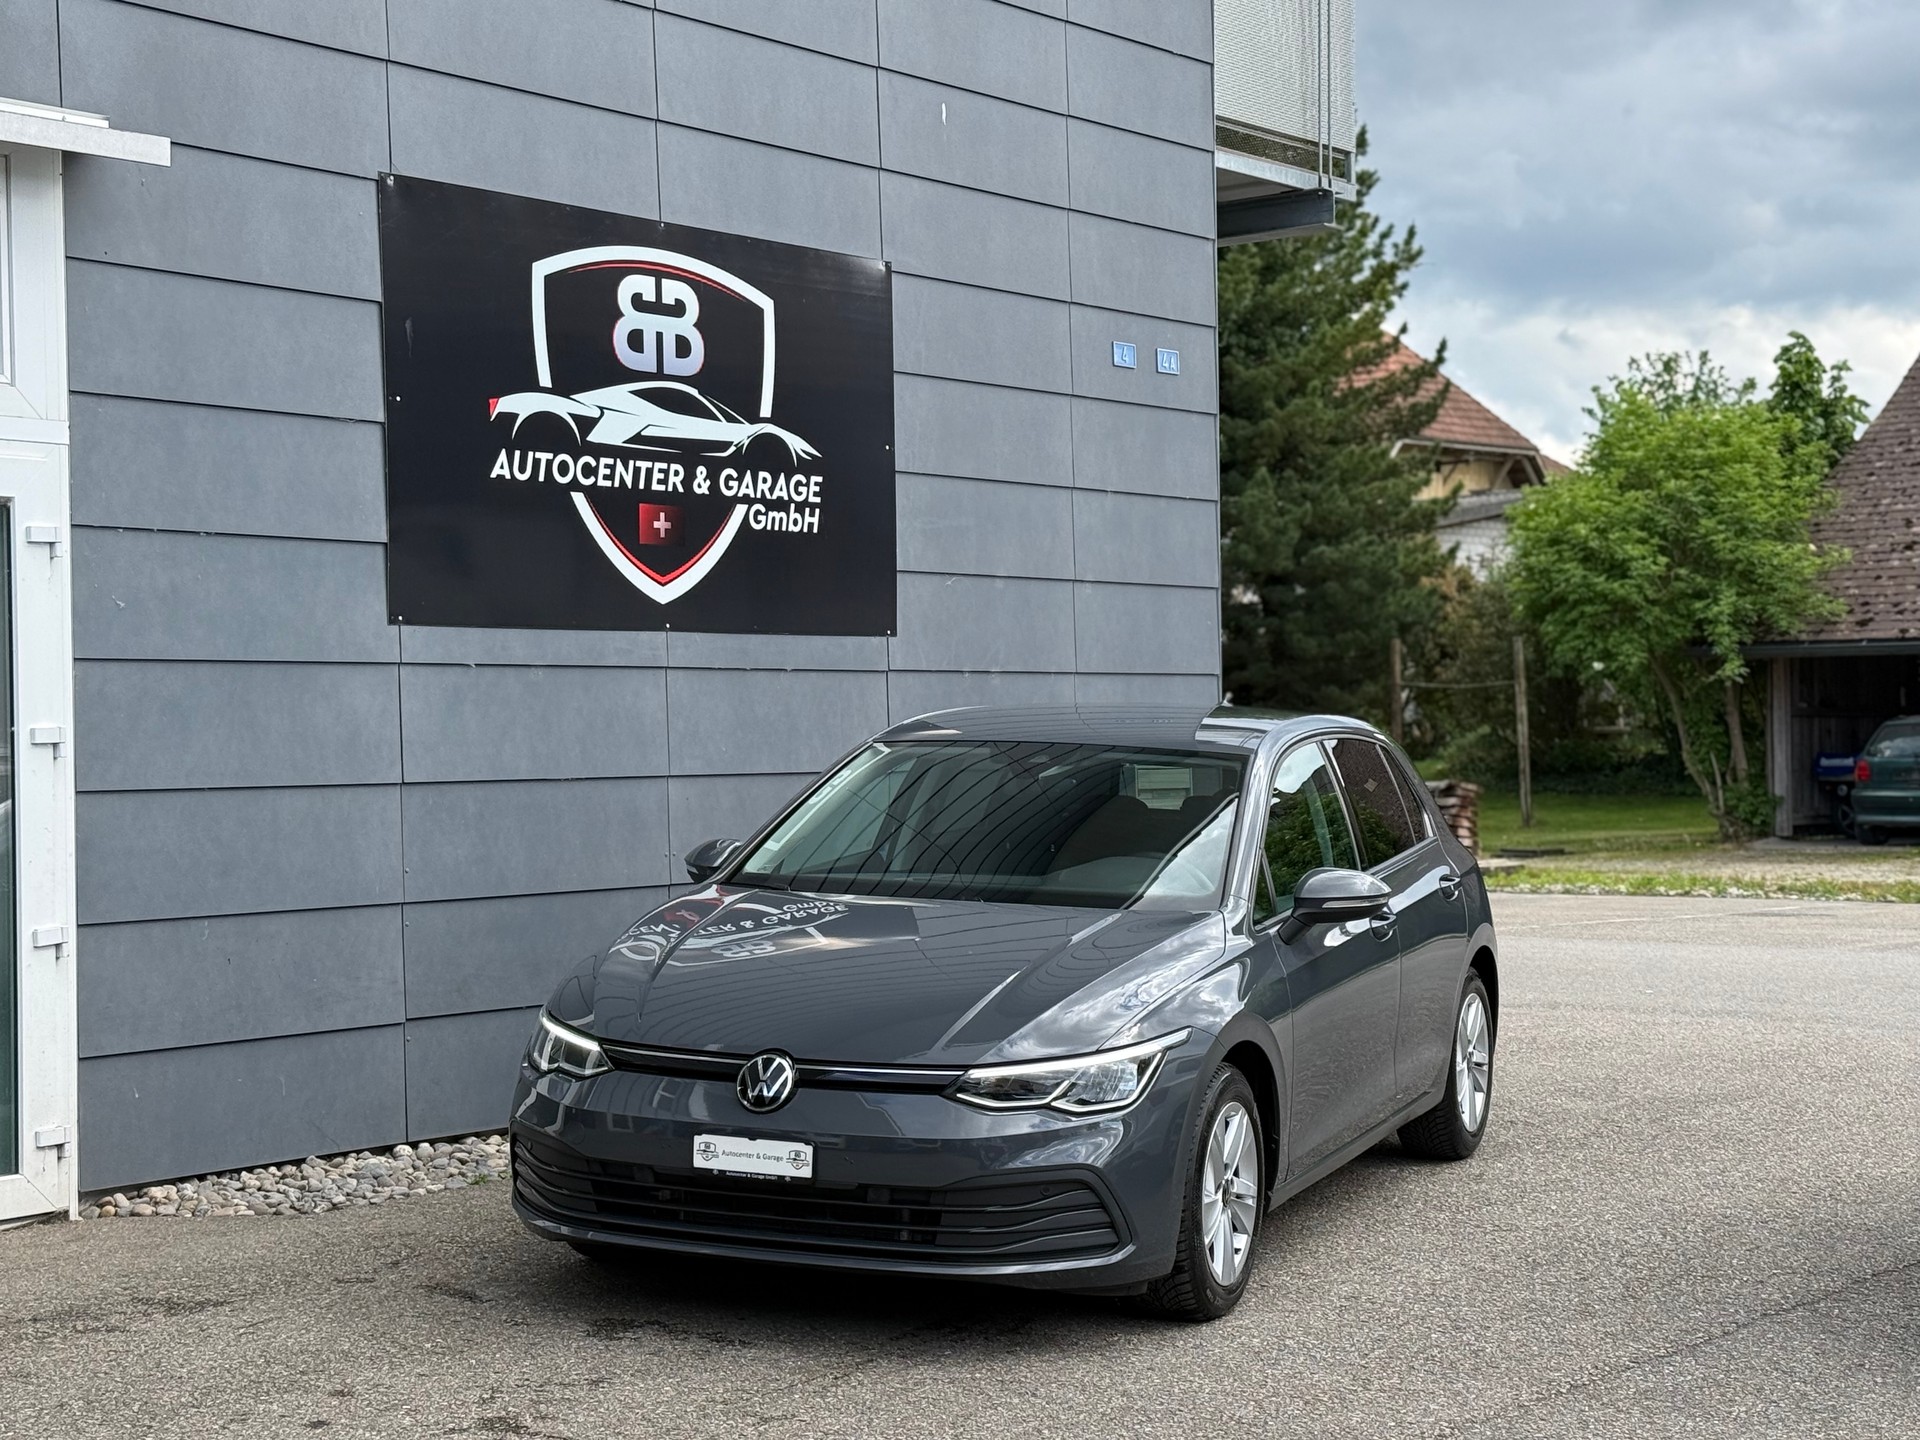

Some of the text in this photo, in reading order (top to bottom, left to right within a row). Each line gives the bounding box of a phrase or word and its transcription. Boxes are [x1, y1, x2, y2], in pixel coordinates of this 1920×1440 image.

[1121, 346, 1129, 363] 4
[489, 448, 824, 504] AUTOCENTER & GARAGE
[748, 503, 821, 534] GmbH
[721, 1149, 755, 1160] Autocenter
[756, 1152, 762, 1160] &
[762, 1153, 784, 1163] Garage
